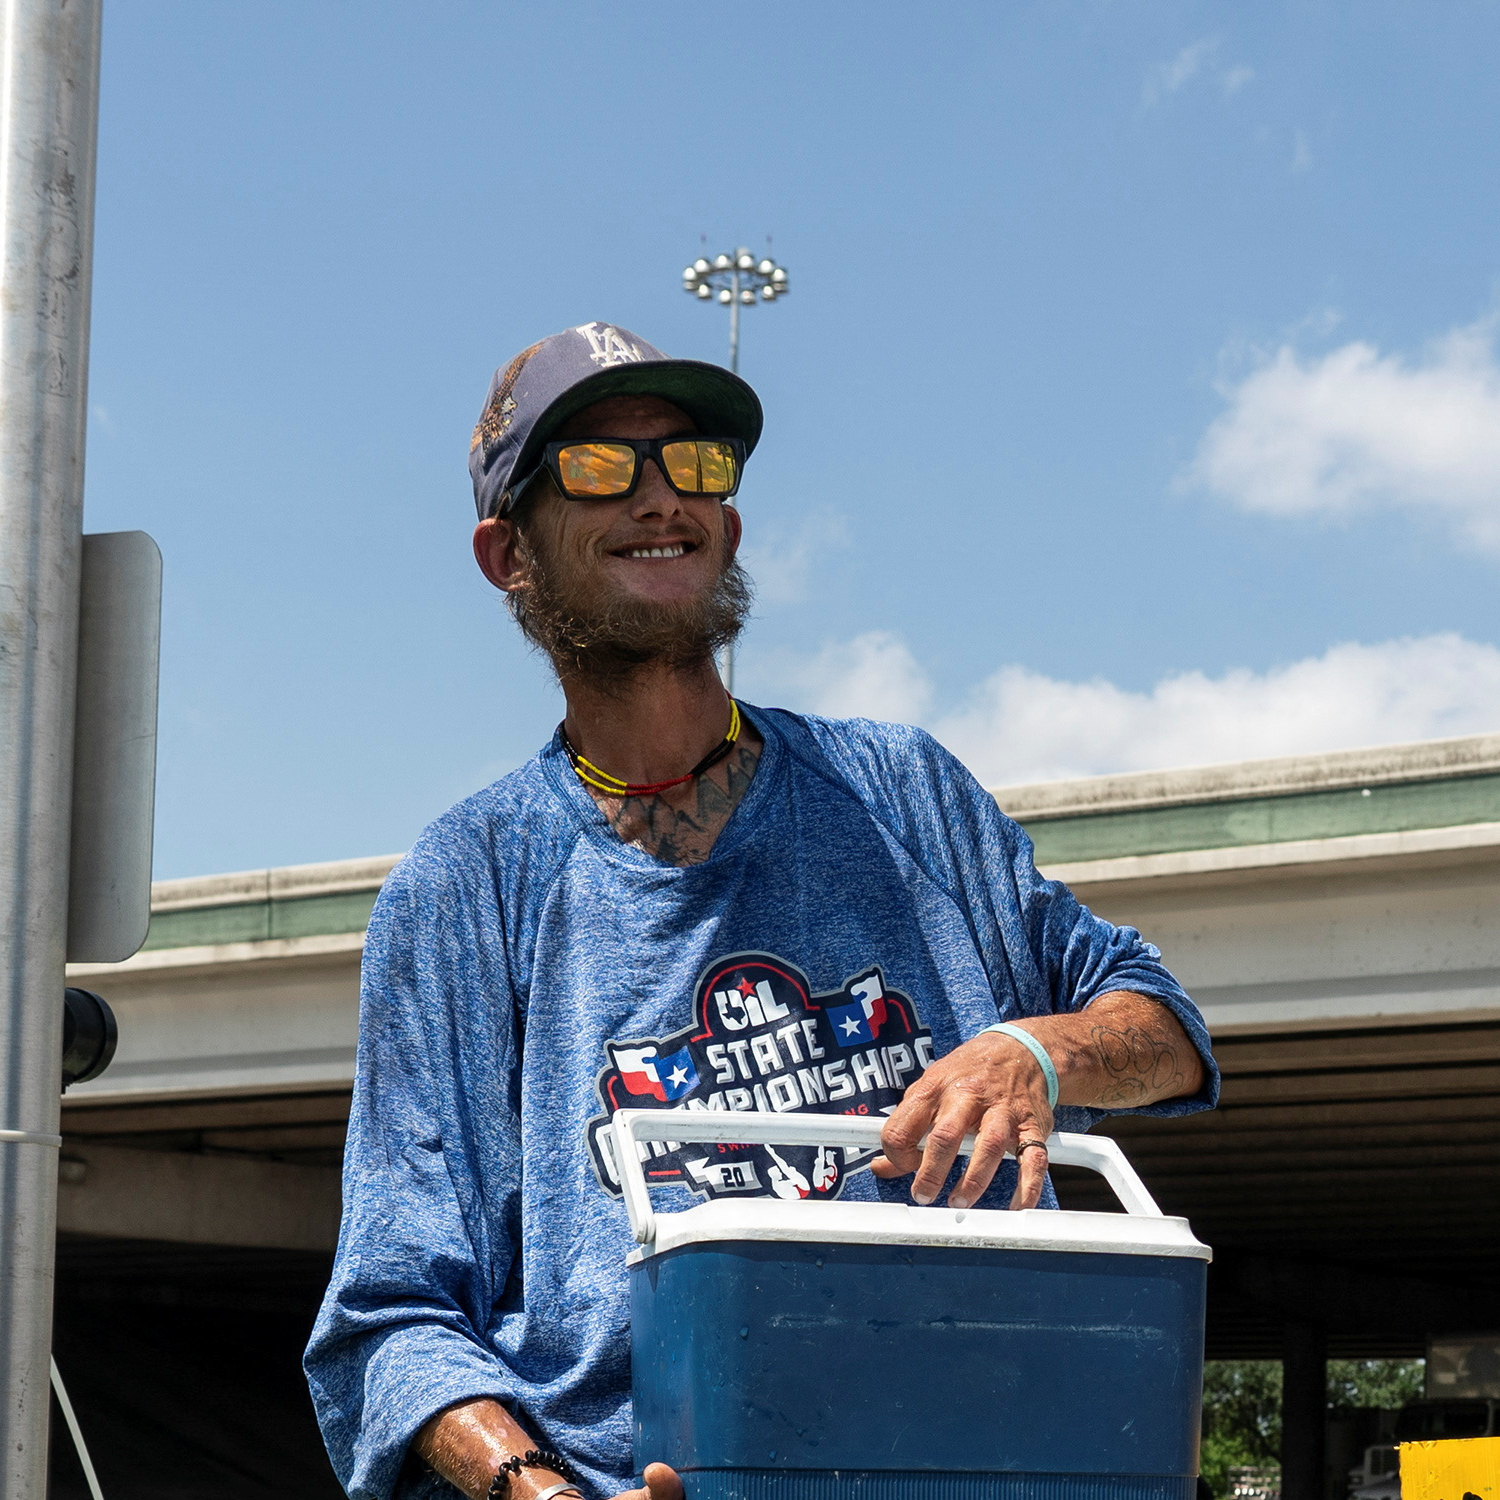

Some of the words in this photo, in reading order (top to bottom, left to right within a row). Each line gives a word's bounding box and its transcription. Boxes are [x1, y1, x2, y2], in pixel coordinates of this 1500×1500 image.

[576, 322, 645, 367] LA
[714, 979, 790, 1031] UIL
[706, 1018, 825, 1084] STATE
[720, 1167, 746, 1188] 20
